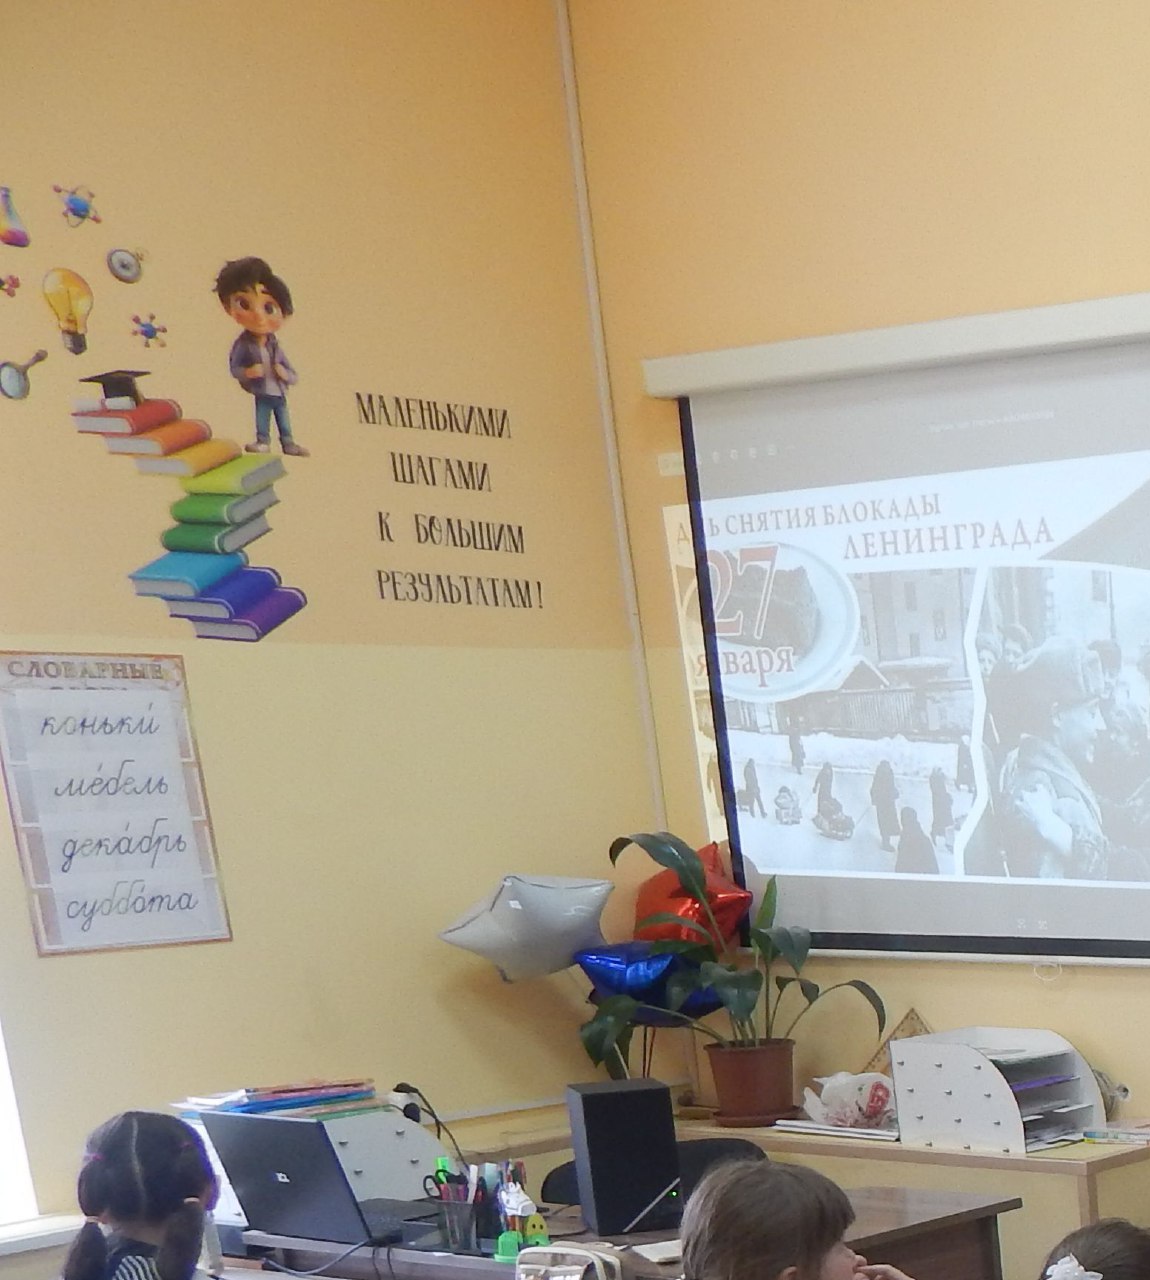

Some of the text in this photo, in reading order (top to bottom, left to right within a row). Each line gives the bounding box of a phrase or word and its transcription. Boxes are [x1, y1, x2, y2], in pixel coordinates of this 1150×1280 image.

[355, 392, 512, 439] МАЛЕНЬКИМИ
[390, 451, 492, 492] ШАГАМИ
[378, 511, 524, 554] К БОЛЬШИМ
[725, 507, 815, 537] СНЯТИЯ
[823, 493, 942, 526] БЛОКАДЫ
[843, 515, 1055, 561] ЛЕНИНГРАДА
[377, 569, 543, 609] РЕЗУЛЬТАТАМ!
[707, 543, 780, 640] 27
[8, 660, 164, 680] СЛОВАРНЫЕ
[695, 646, 796, 688] яваря
